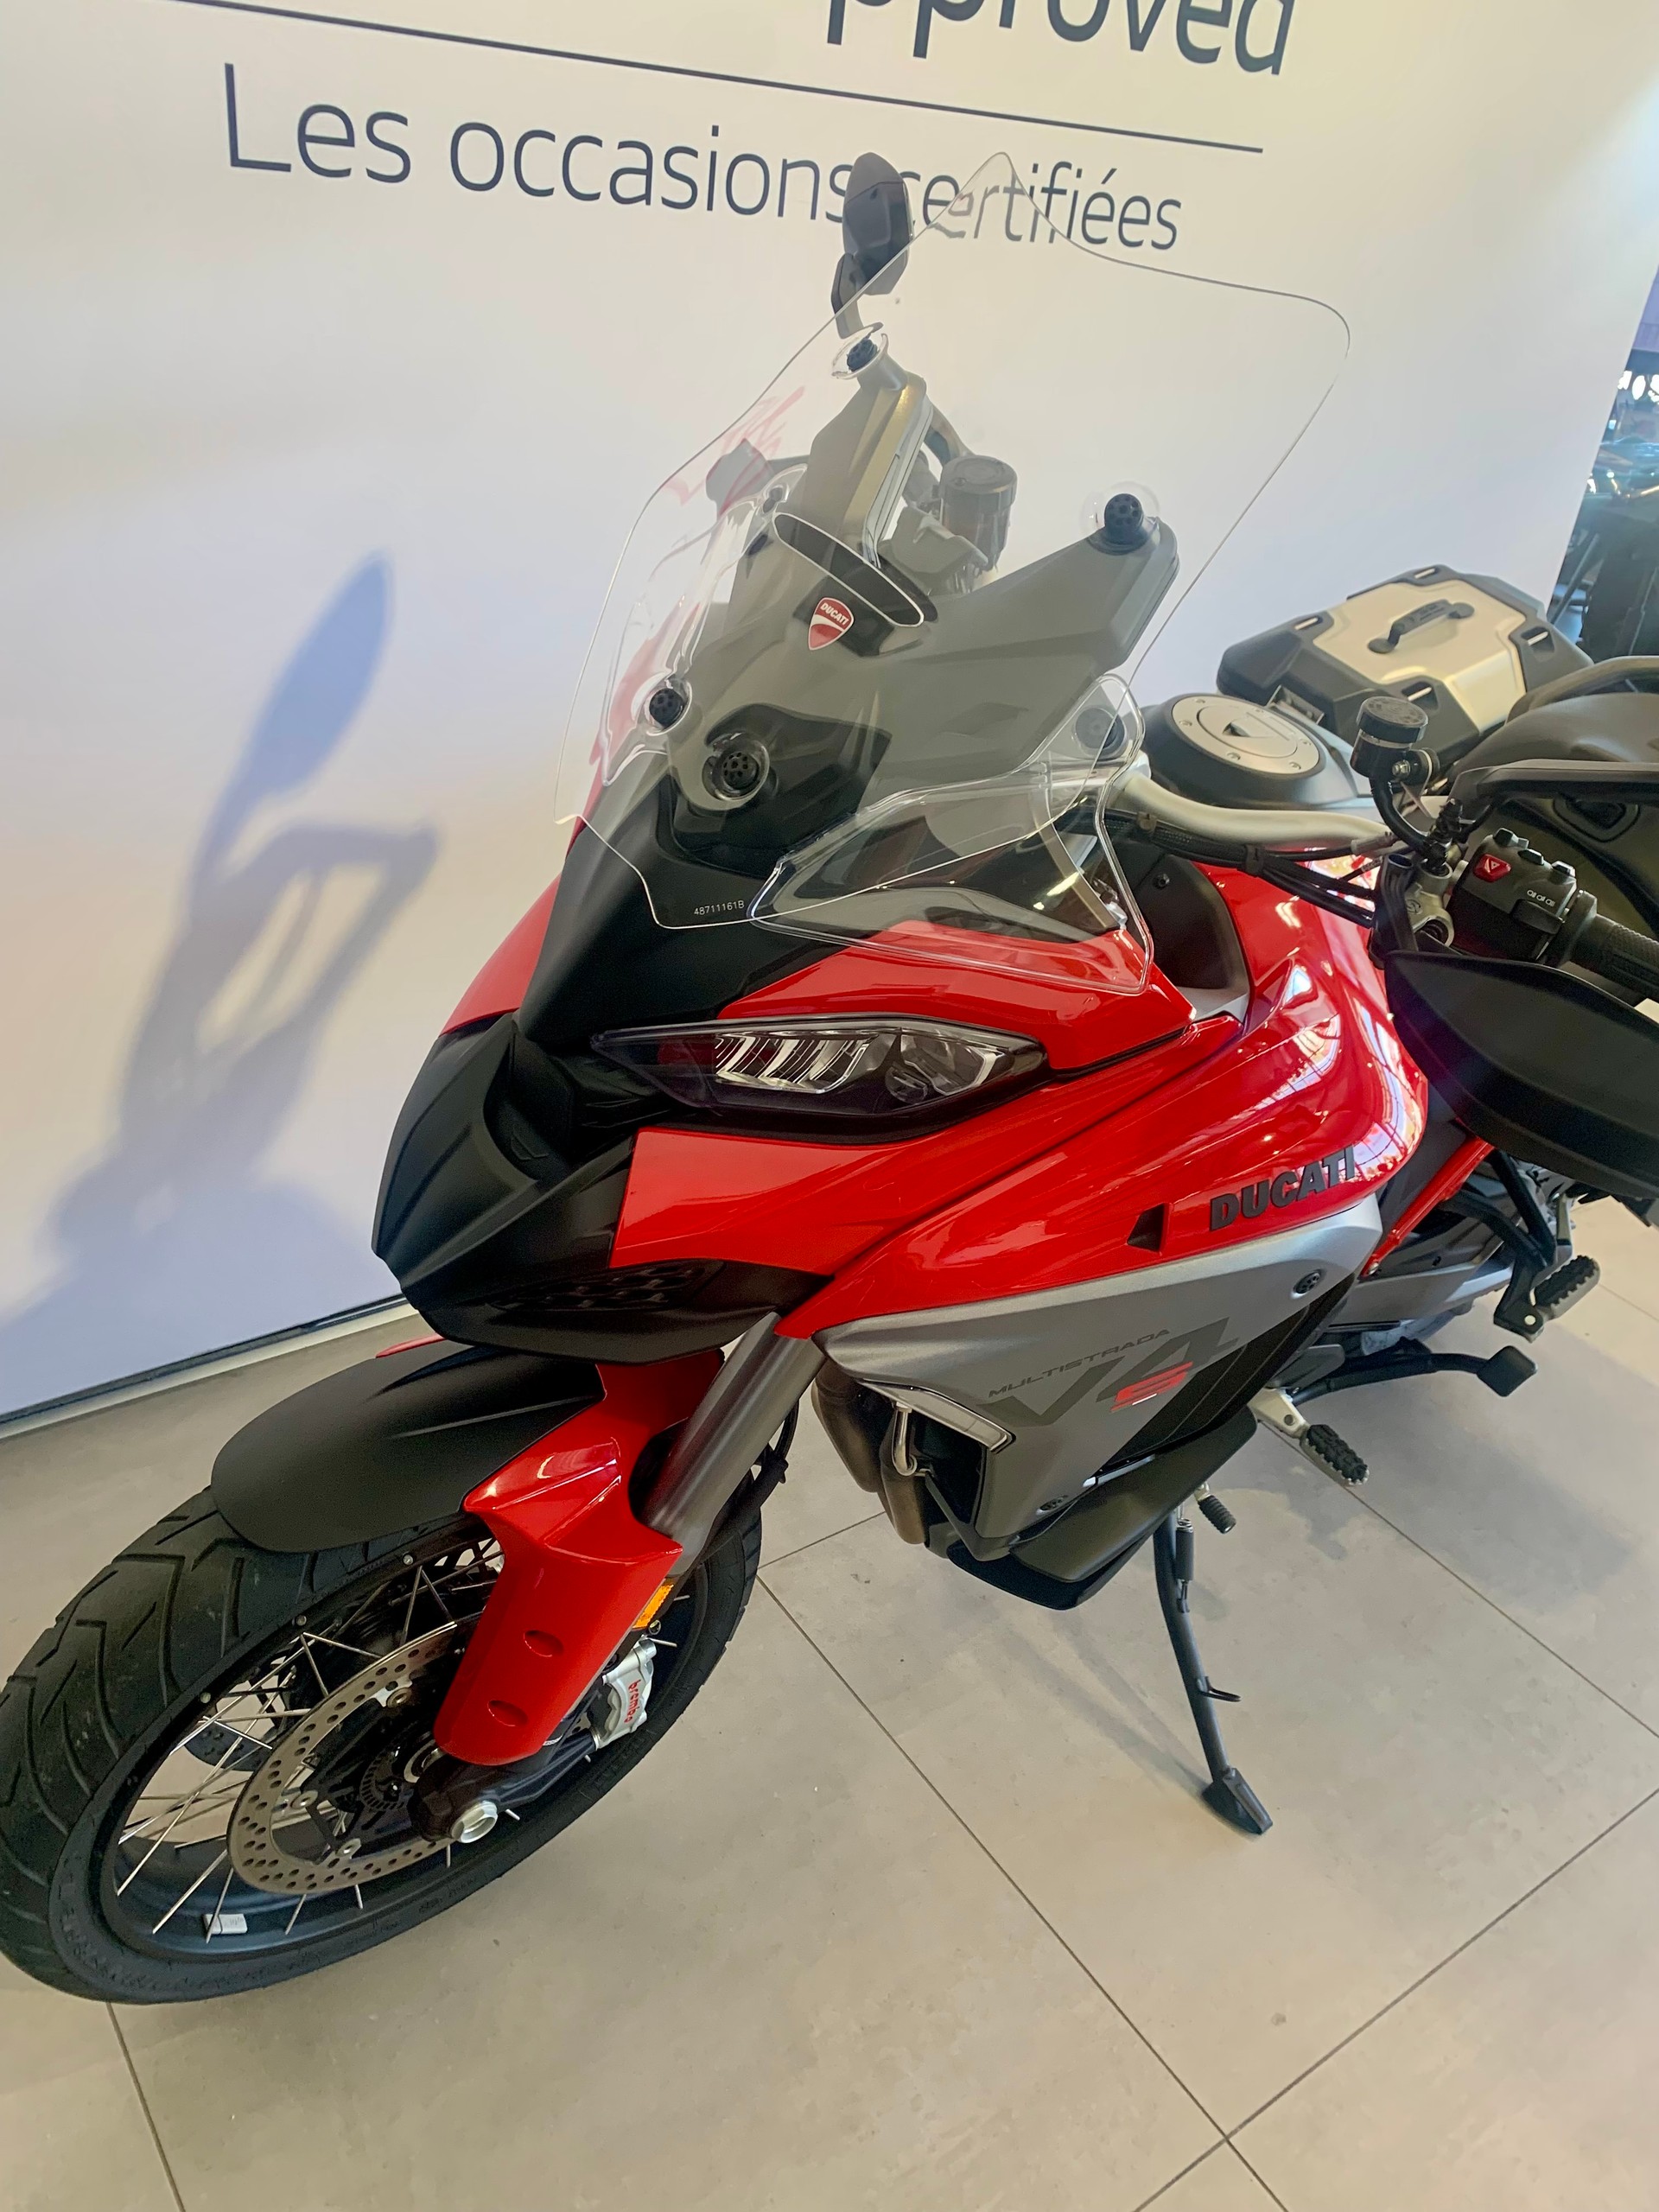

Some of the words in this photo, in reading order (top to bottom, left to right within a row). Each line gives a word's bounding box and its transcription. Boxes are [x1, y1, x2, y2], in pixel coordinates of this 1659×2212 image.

[224, 62, 412, 184] Les
[449, 124, 854, 224] occasions
[820, 602, 849, 626] DUCATI
[694, 899, 745, 915] 48711161B
[1210, 1143, 1356, 1231] DUCATI
[988, 1329, 1171, 1398] MULTISTRADA
[624, 1679, 642, 1724] brembo
